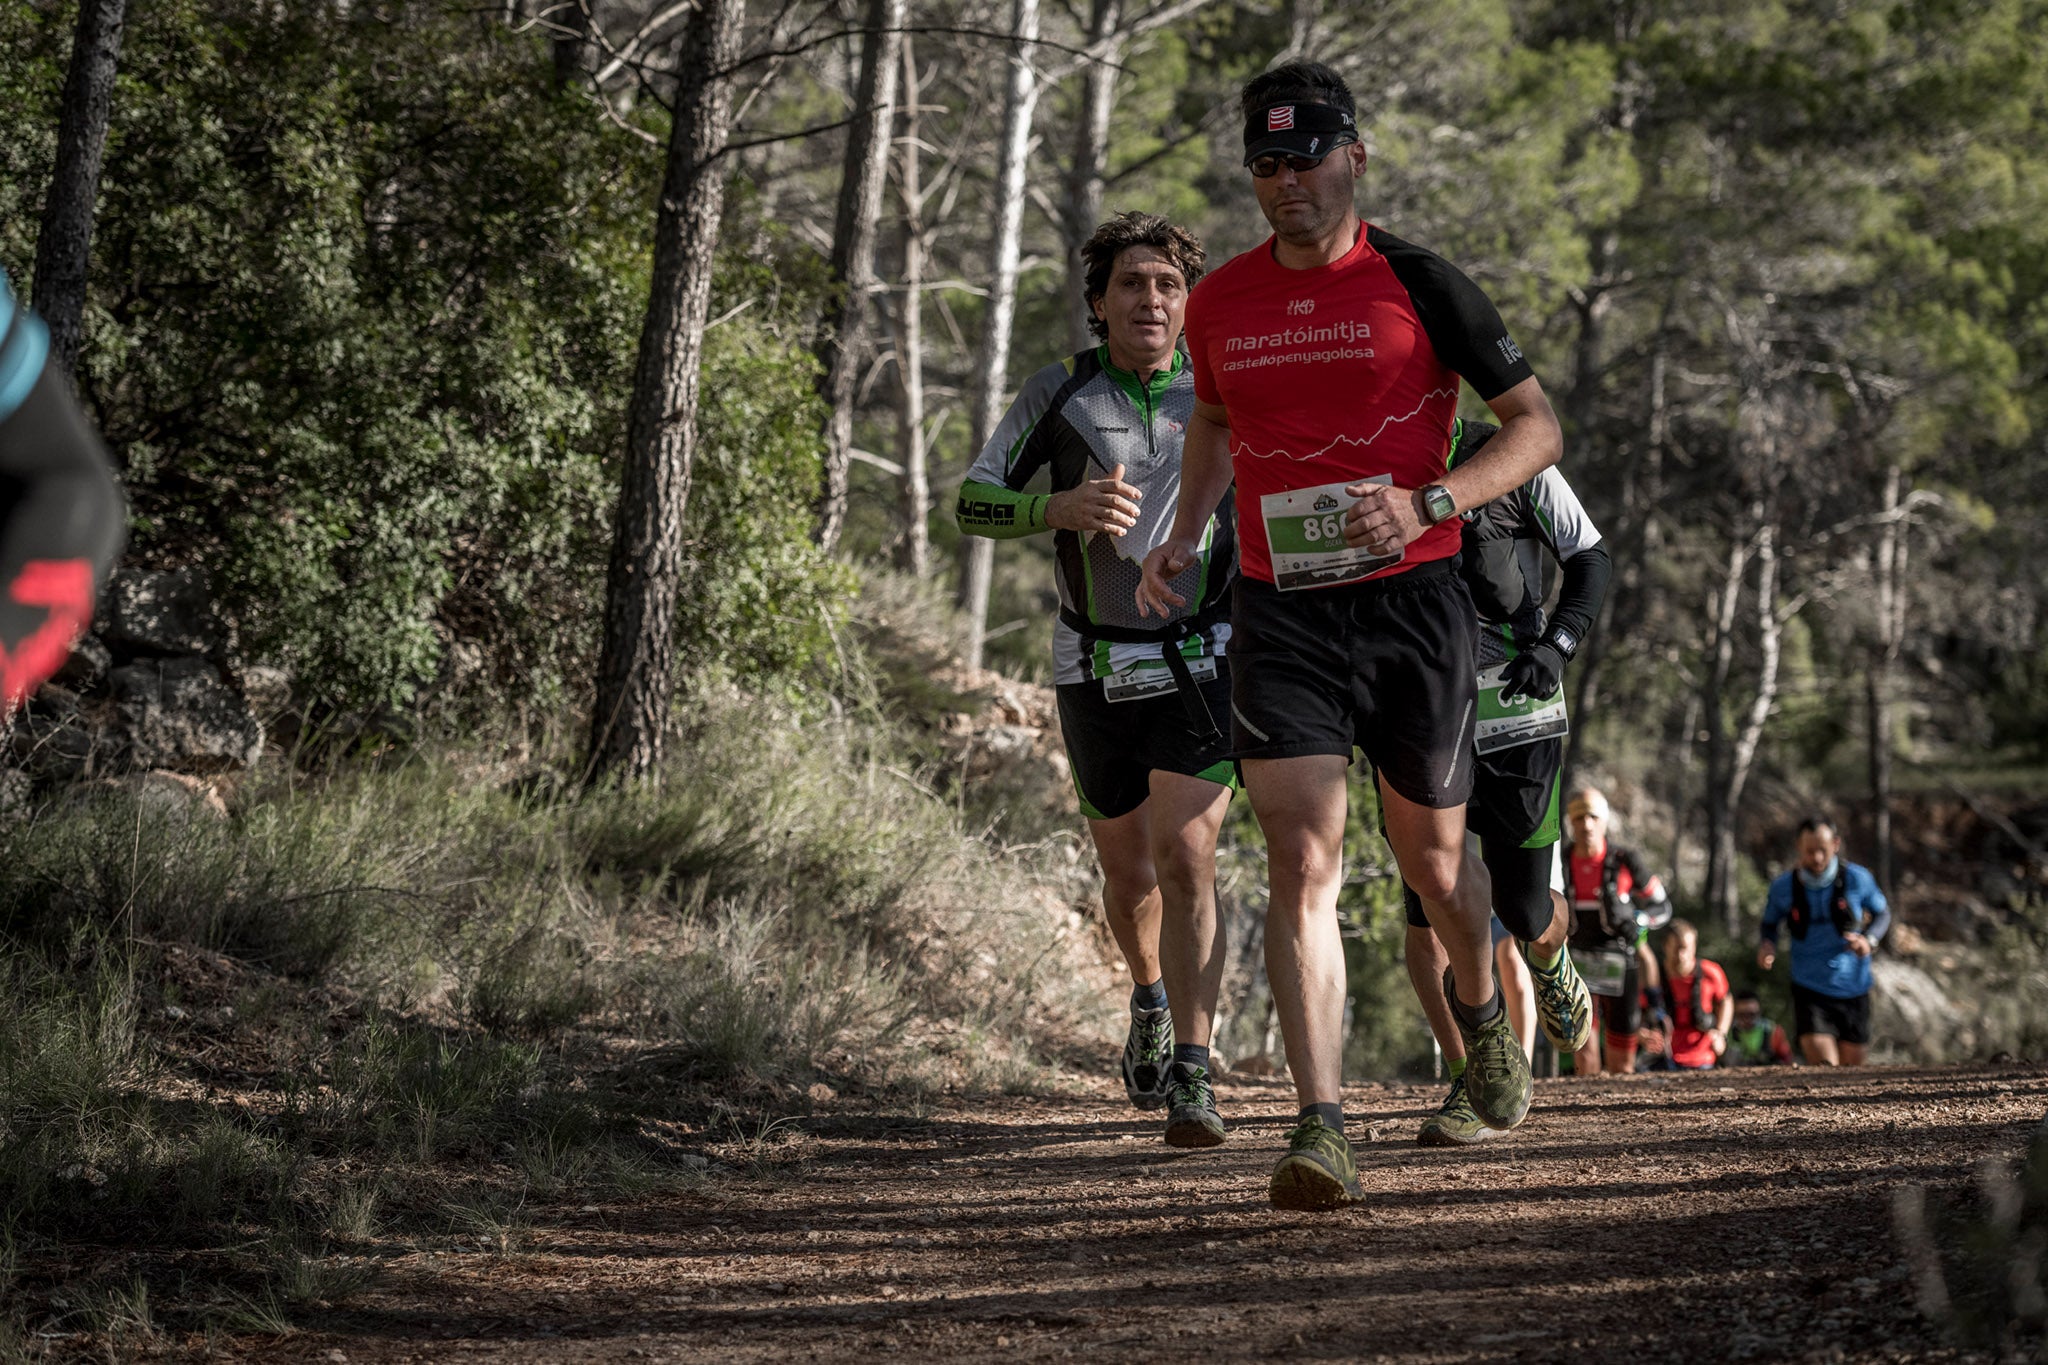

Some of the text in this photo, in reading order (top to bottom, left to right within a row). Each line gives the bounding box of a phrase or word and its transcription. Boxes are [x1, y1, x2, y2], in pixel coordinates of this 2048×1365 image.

[1225, 320, 1371, 352] maratóimitja
[1223, 347, 1375, 371] castellópenyagolosa
[1303, 512, 1348, 541] 86
